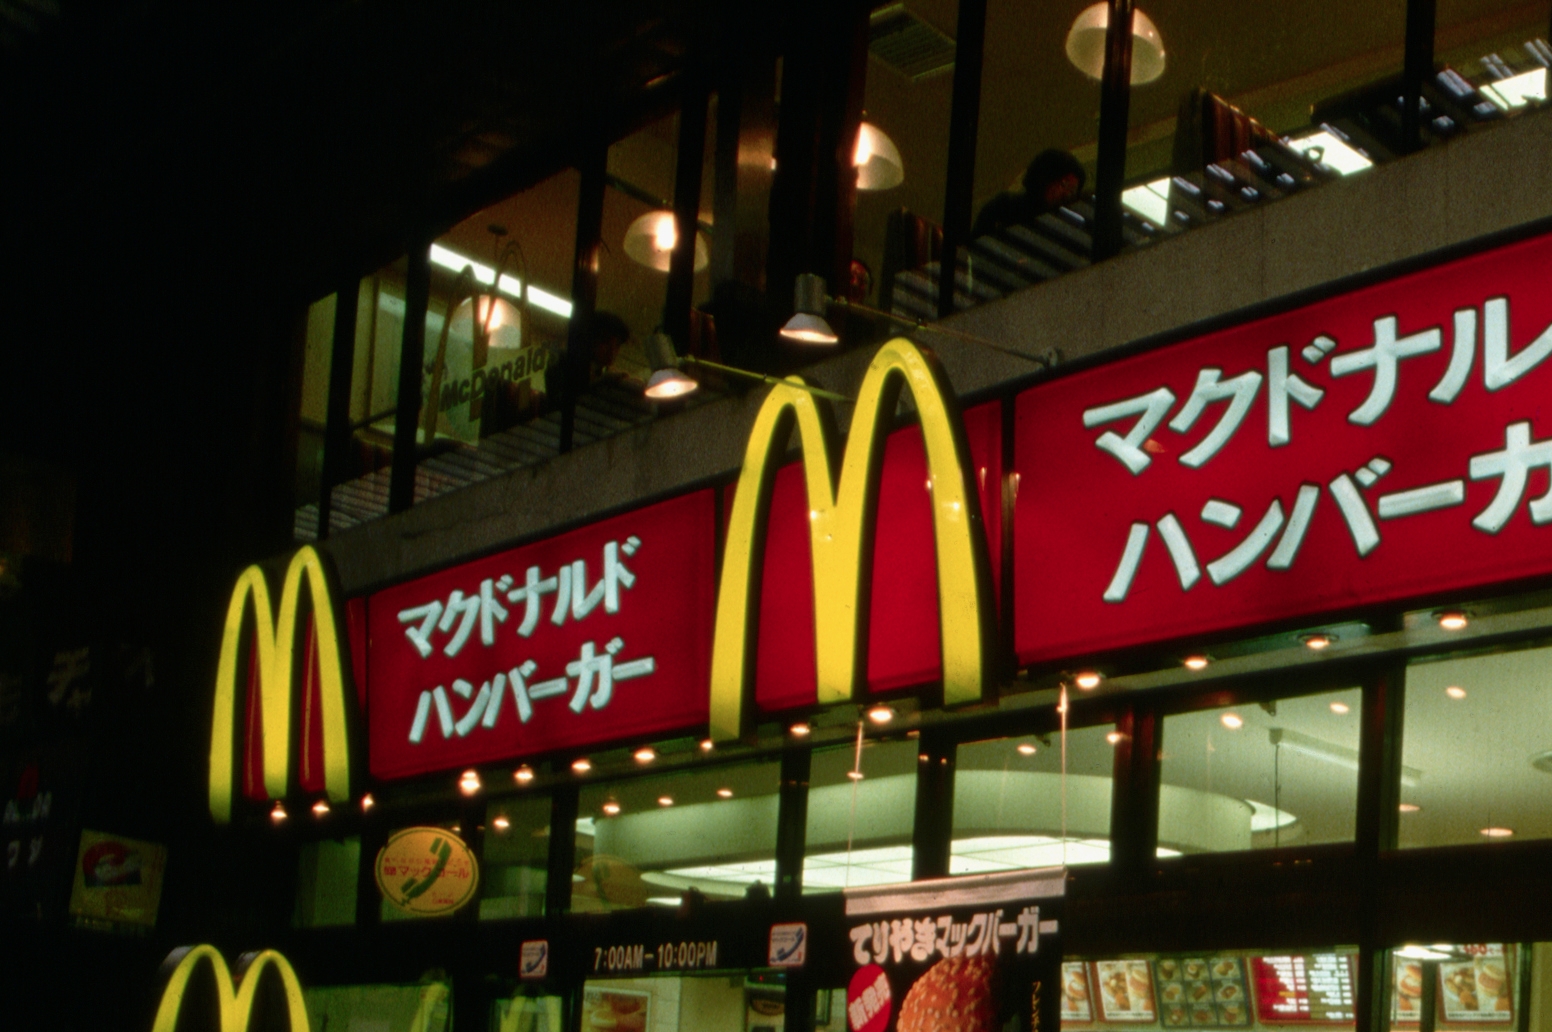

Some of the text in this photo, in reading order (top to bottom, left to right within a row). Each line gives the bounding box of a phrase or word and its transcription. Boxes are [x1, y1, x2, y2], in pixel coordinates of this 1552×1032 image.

[398, 535, 643, 658] マクドナルド
[408, 637, 655, 744] ハンバーガー
[849, 906, 1059, 965] てりやきマックバーガー
